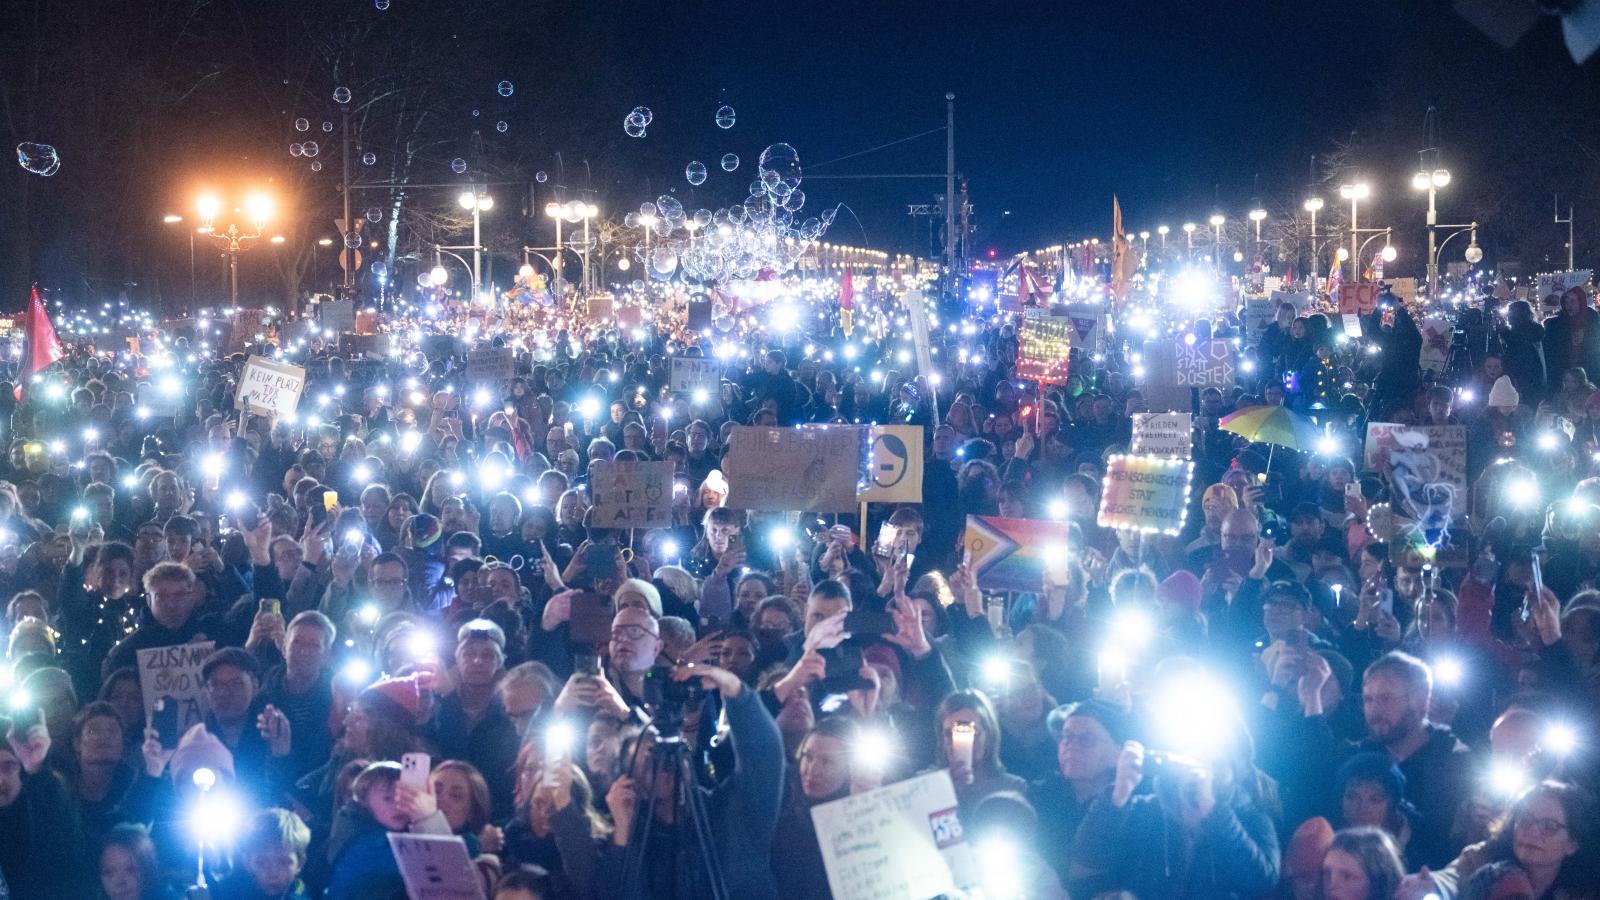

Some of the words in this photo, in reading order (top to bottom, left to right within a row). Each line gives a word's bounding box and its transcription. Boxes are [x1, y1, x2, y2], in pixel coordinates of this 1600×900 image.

[1342, 284, 1380, 305] FCK
[1176, 362, 1232, 385] DÜSTER
[1177, 357, 1208, 371] STATT
[249, 367, 273, 384] KEIN
[275, 376, 300, 393] PLATZ
[250, 389, 277, 407] NAZIS
[1138, 446, 1188, 454] DEMOKRATIE
